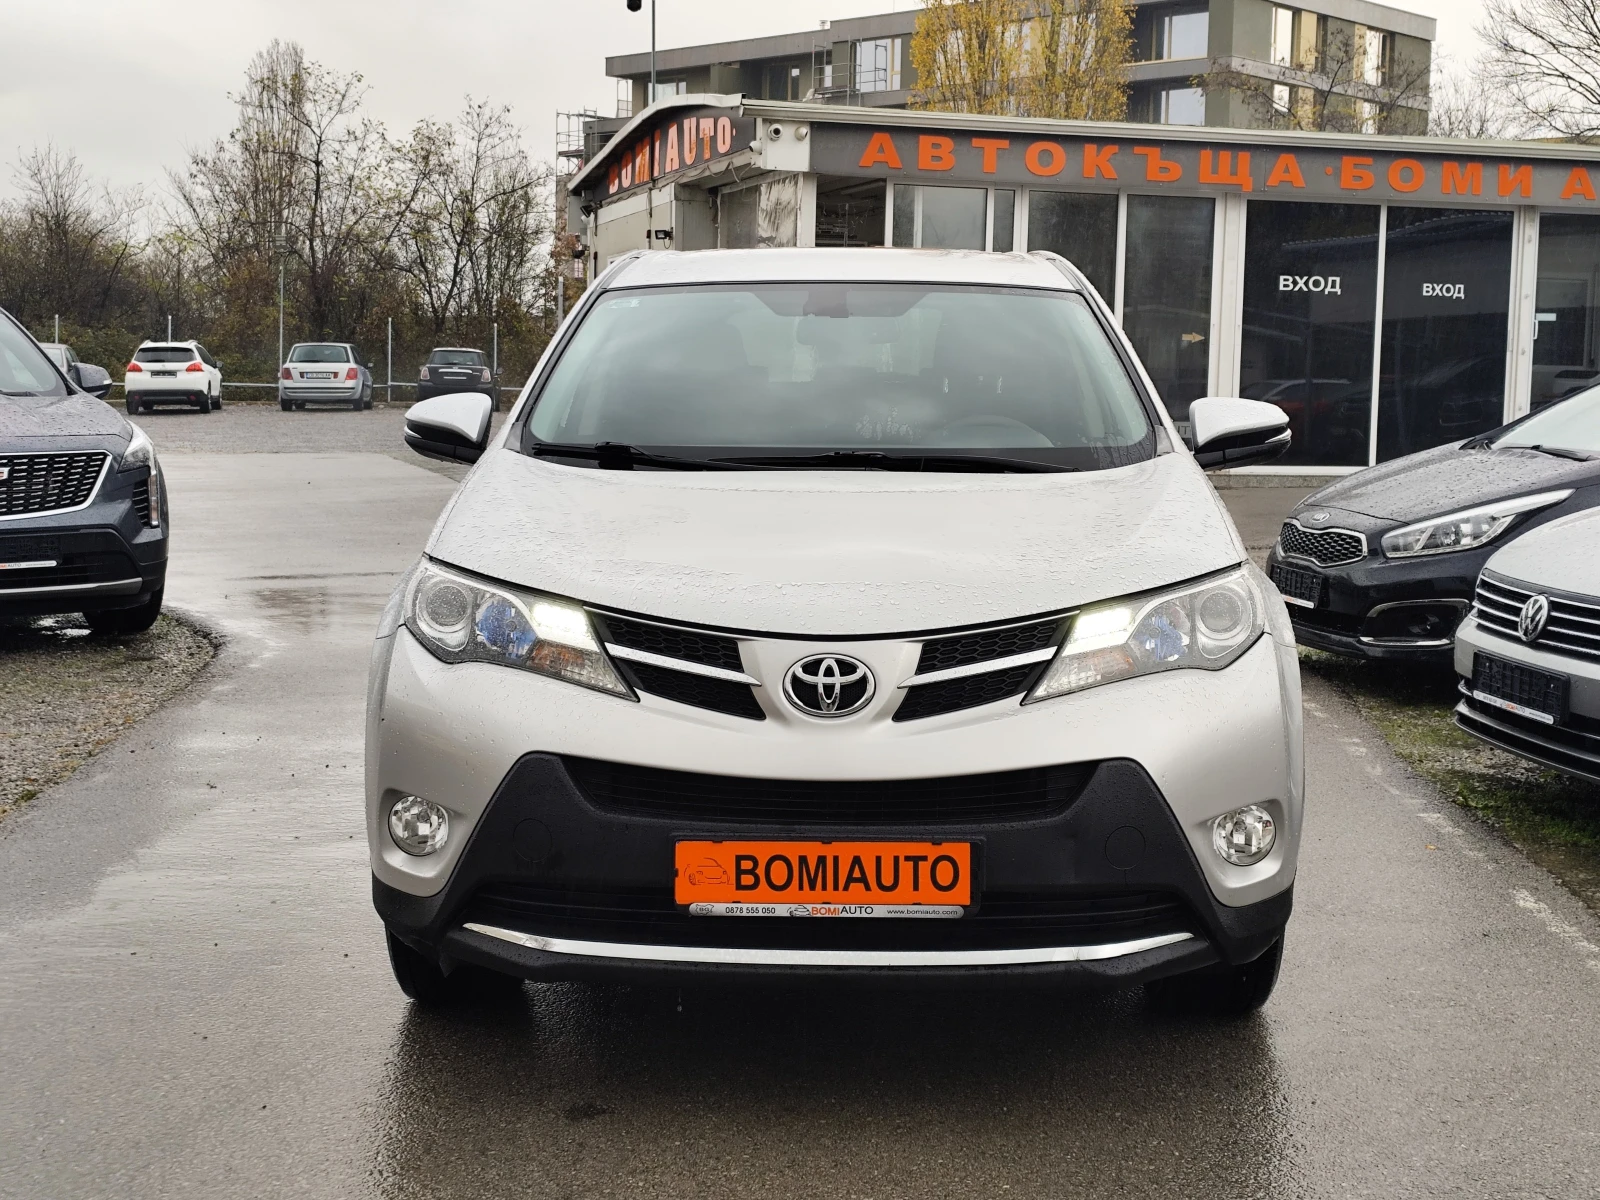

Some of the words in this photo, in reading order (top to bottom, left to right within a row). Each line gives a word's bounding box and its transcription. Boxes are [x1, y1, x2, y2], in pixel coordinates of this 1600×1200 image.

[858, 132, 1306, 193] АВТОКЪЩА
[1340, 156, 1533, 198] БОМИ
[1279, 275, 1342, 295] ВХОД
[1422, 282, 1465, 299] ВХОД
[734, 854, 960, 892] BOMIAUTO
[725, 906, 744, 914] 0878
[761, 907, 776, 915] 050
[811, 906, 874, 916] BOMIAUTO
